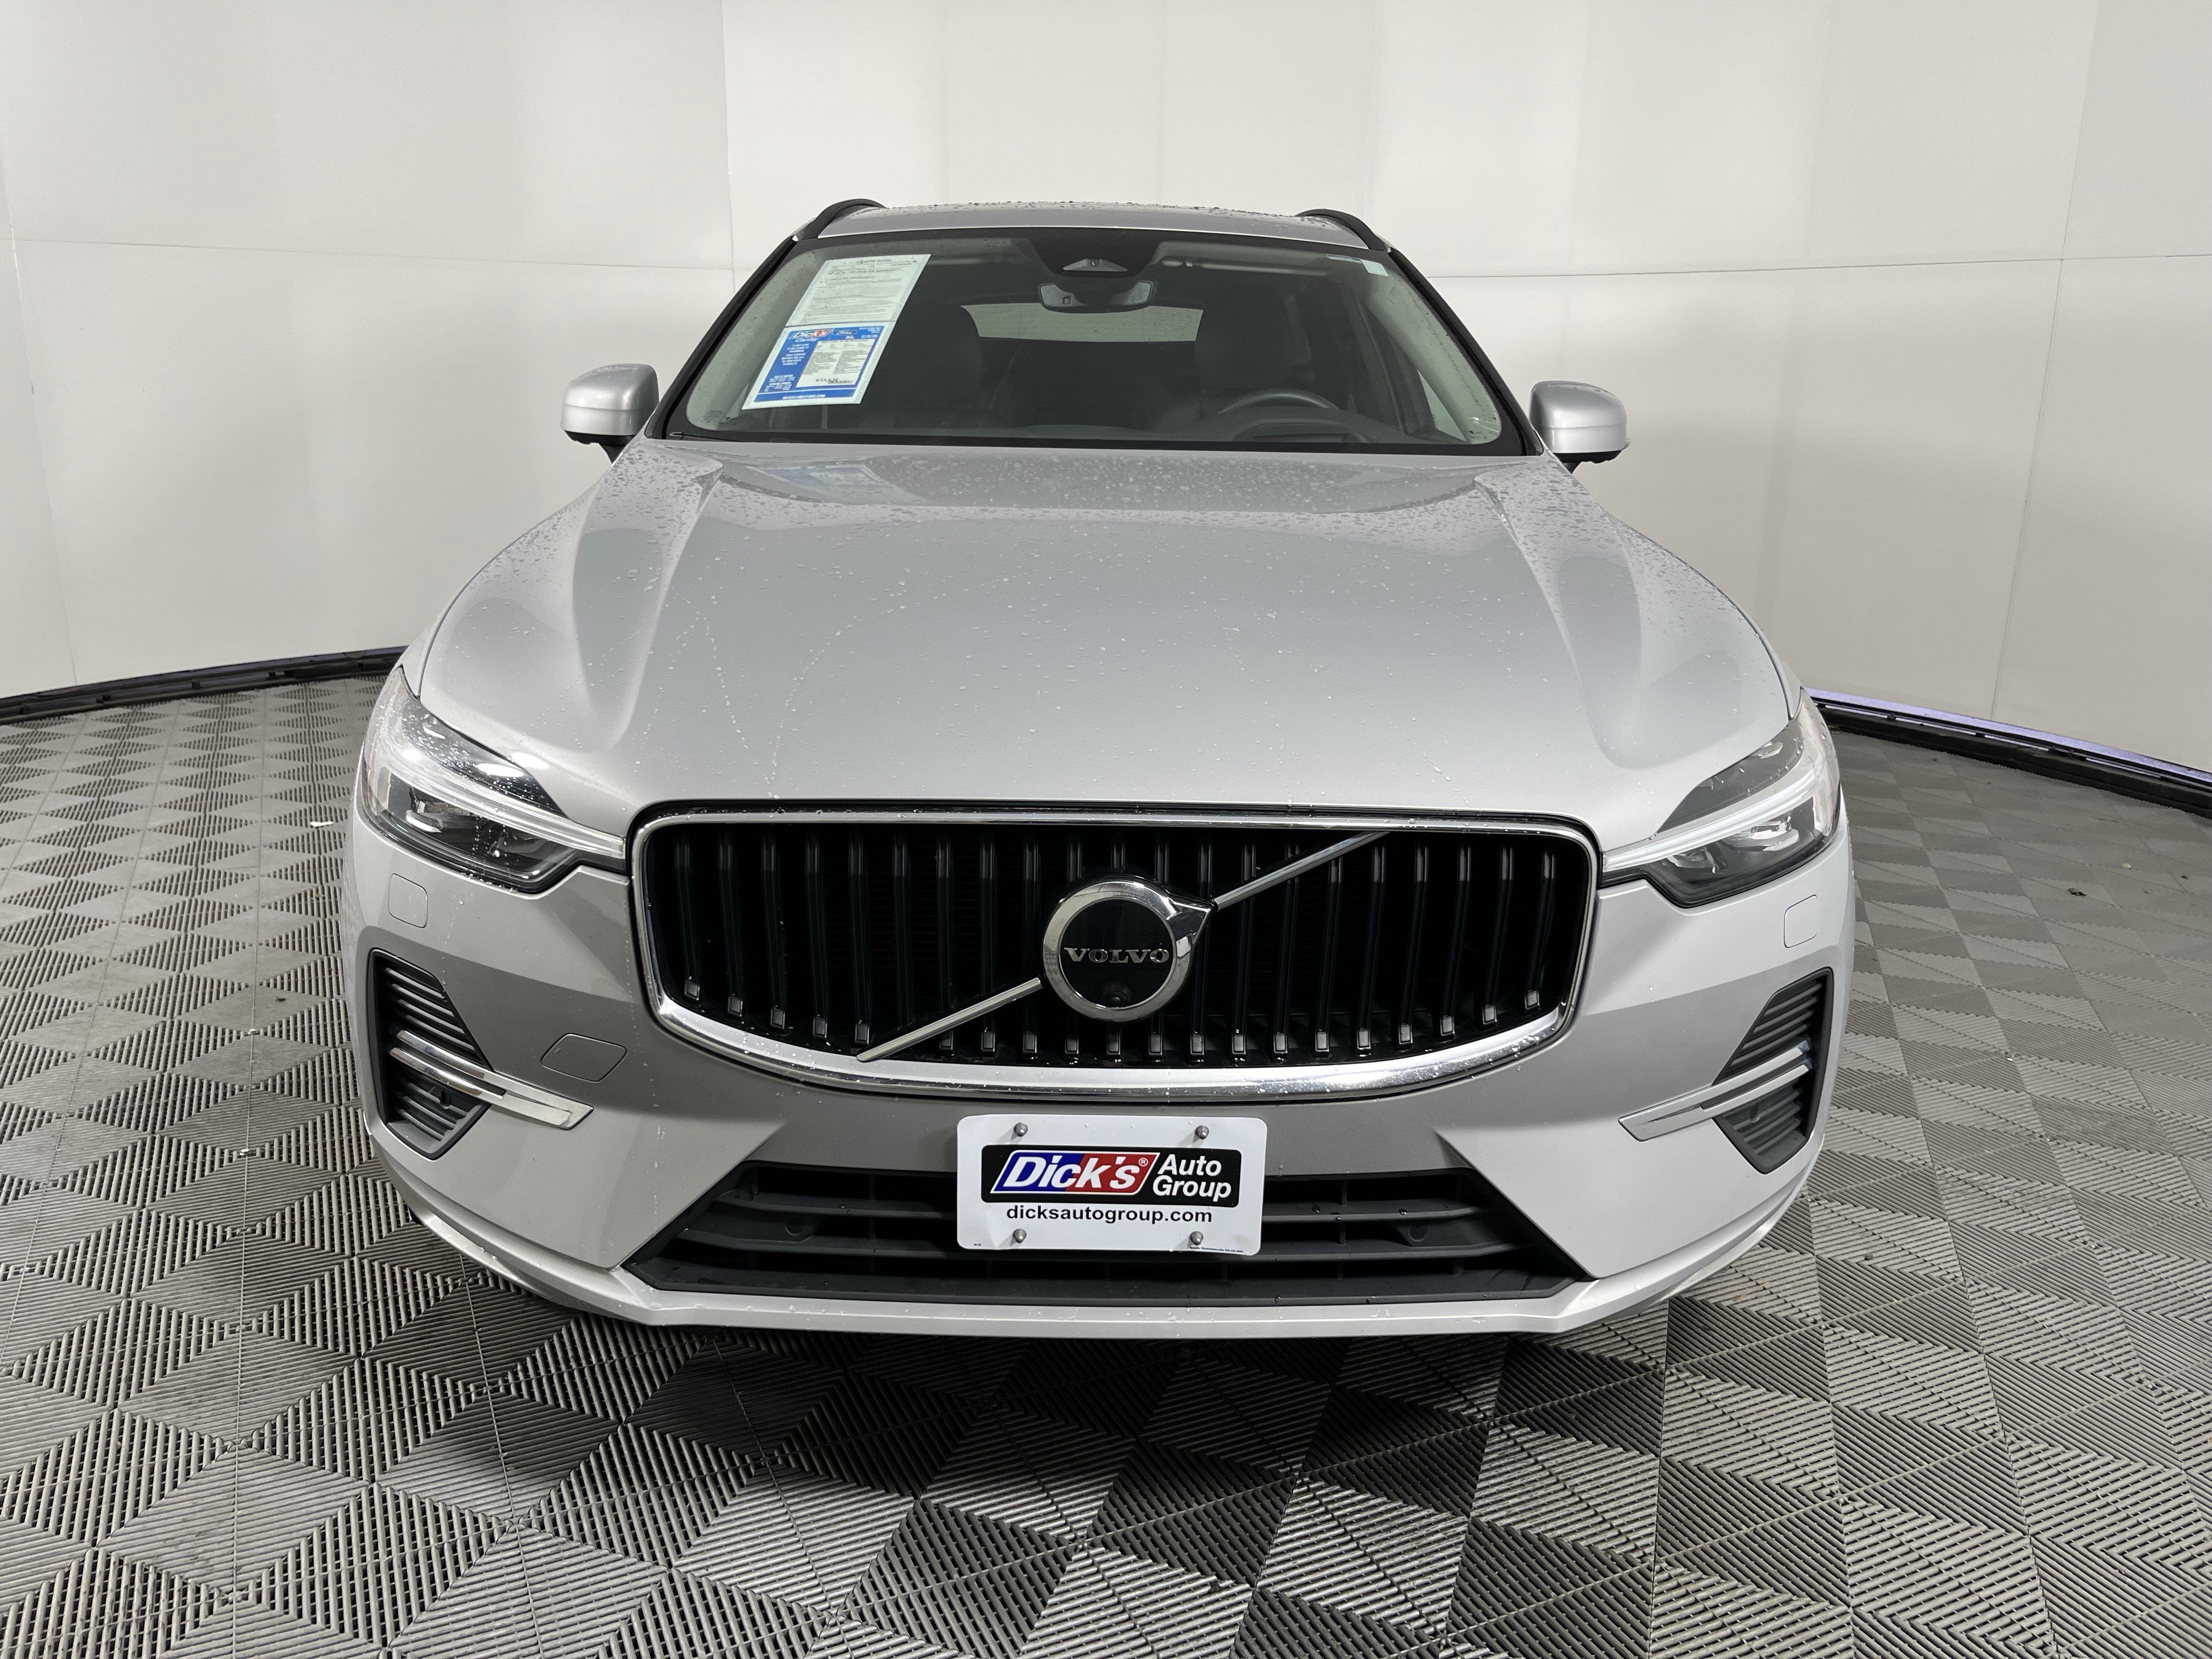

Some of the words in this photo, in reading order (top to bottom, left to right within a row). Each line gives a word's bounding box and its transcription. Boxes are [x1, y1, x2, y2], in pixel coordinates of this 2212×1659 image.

[1064, 947, 1170, 963] VOLVO
[1003, 1155, 1141, 1189] Dick's
[1158, 1154, 1222, 1177] Auto
[1153, 1175, 1232, 1203] Group
[1007, 1205, 1212, 1224] dicksautogroup.com
